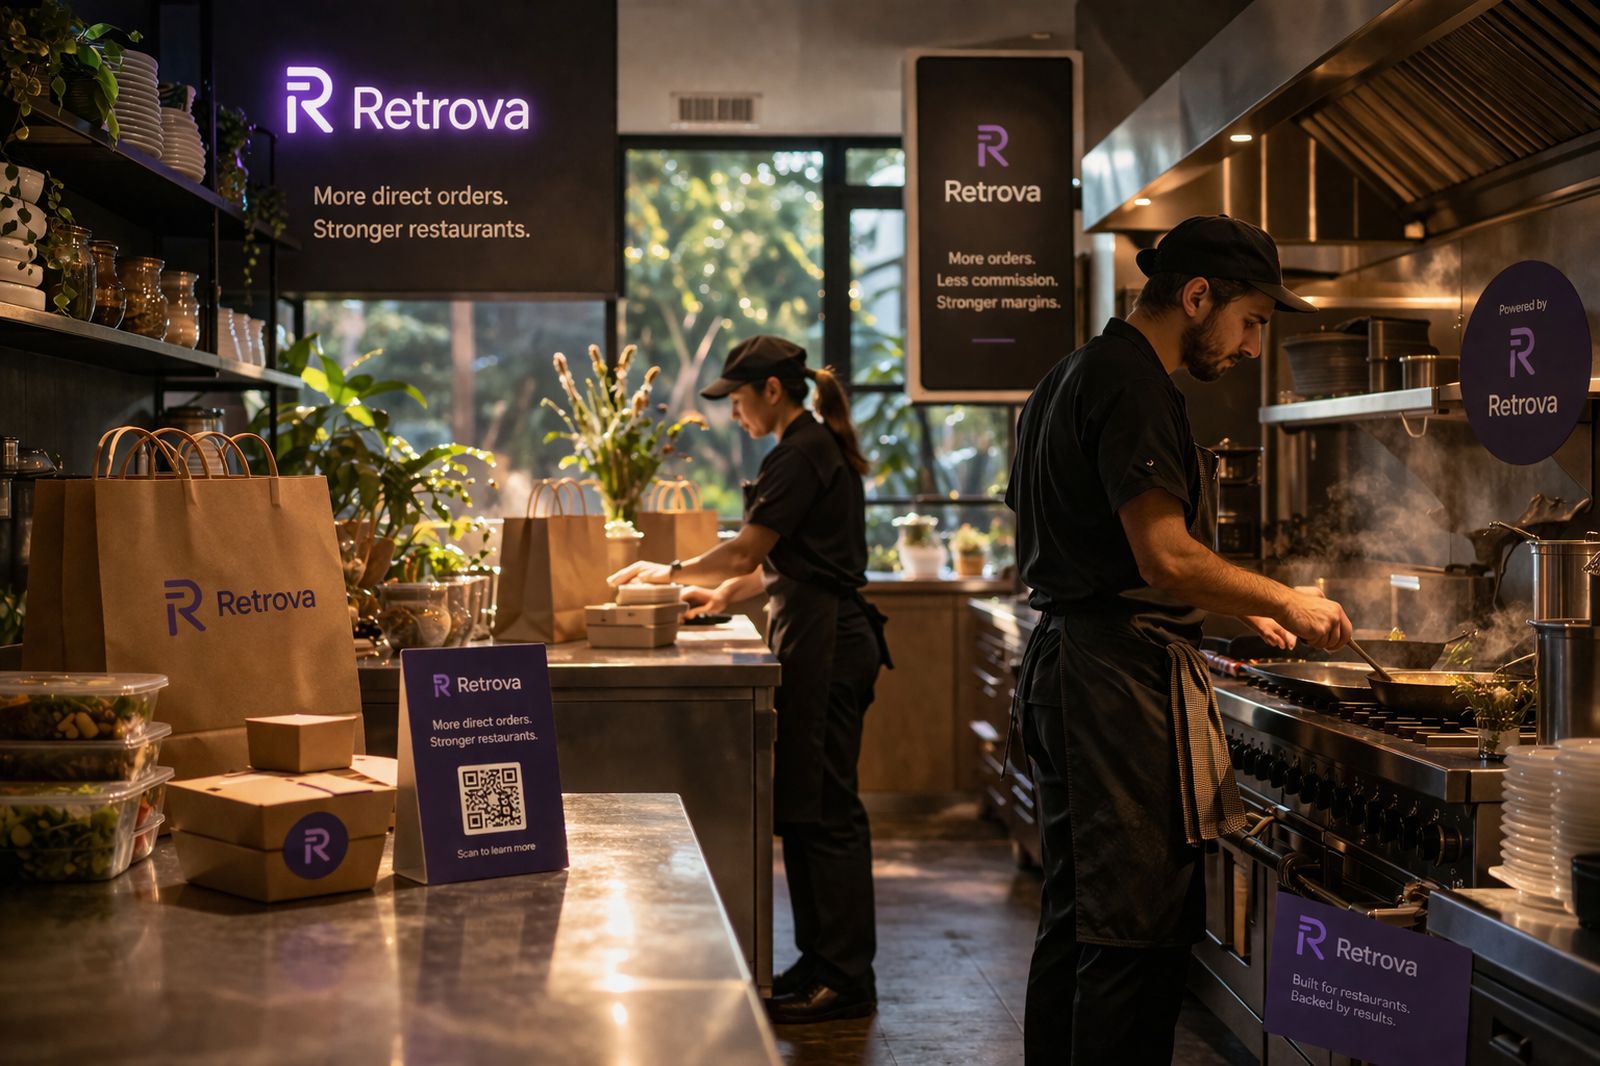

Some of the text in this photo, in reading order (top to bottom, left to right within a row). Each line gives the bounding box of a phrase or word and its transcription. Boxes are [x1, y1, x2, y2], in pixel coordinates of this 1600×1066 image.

[354, 86, 529, 130] Retrova
[314, 185, 508, 205] More direct orders.
[945, 180, 1041, 202] Retrova
[314, 219, 530, 243] Stronger restaurants.
[949, 252, 1036, 265] More orders.
[937, 273, 1058, 287] Less commission.
[937, 295, 1061, 312] Stronger margins.
[1500, 299, 1547, 315] Powered by
[1488, 394, 1558, 416] Retrova
[217, 588, 316, 616] Retrova
[457, 676, 521, 693] Retrova
[433, 715, 532, 730] More direct orders.
[430, 731, 538, 748] Stronger restaurants.
[457, 843, 536, 859] Scan to learn more
[1336, 937, 1418, 977] Retrova
[1293, 974, 1410, 1014] Built for restaurants.
[1291, 990, 1396, 1026] Backed by results.
